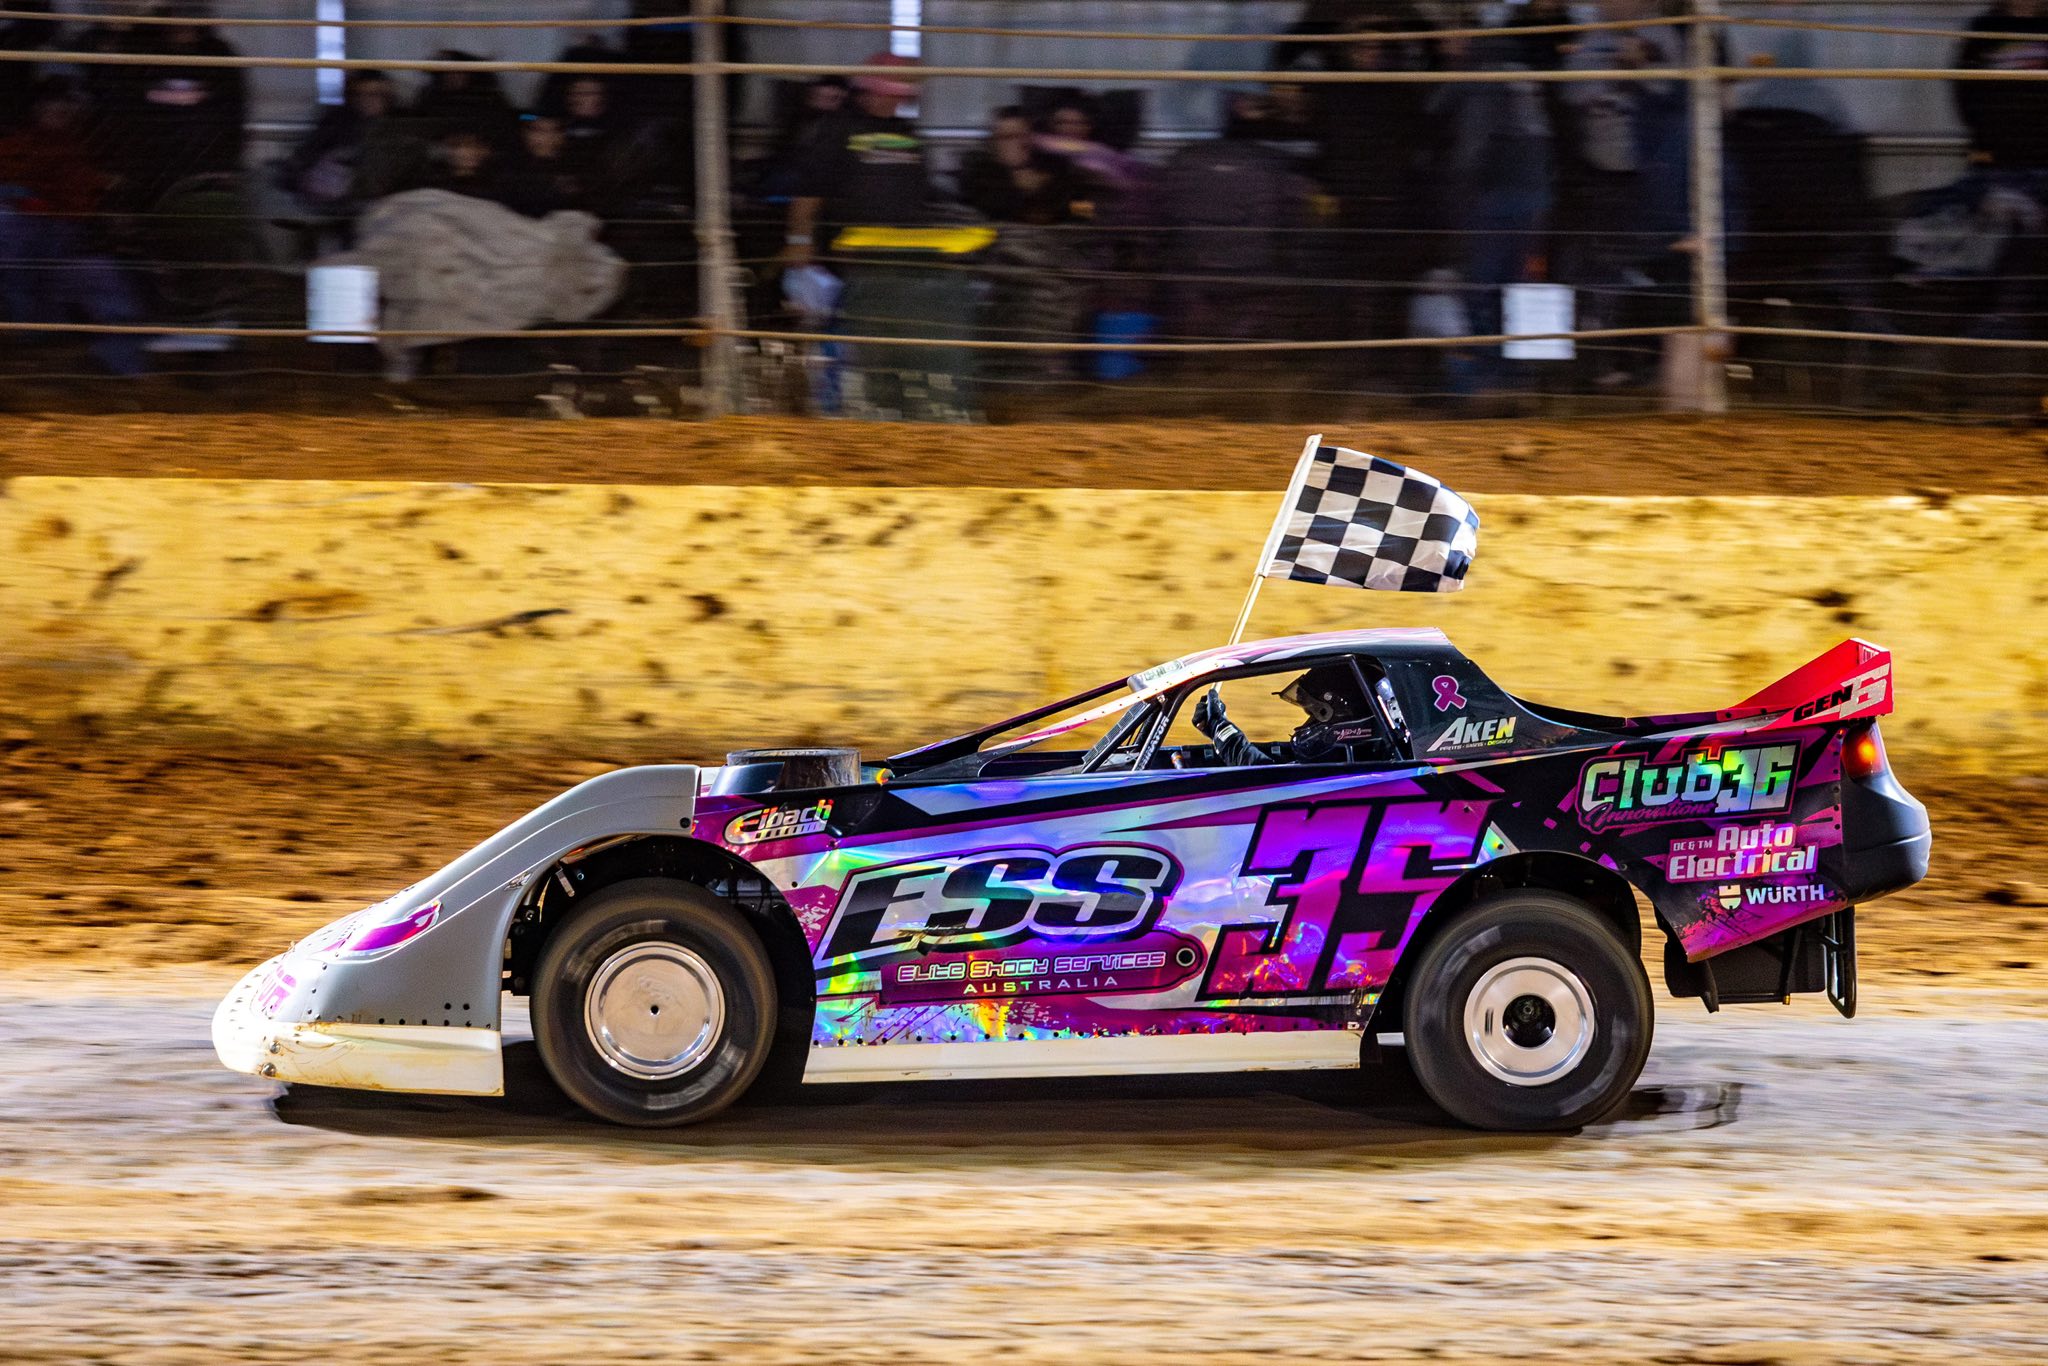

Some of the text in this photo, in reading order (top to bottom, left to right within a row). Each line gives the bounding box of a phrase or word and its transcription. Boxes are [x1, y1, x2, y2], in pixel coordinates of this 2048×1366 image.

[1426, 716, 1517, 752] AKEN
[1581, 745, 1797, 813] Club36
[724, 799, 834, 844] Eibach
[1697, 839, 1713, 849] TM
[1718, 824, 1794, 851] Auto
[1669, 845, 1816, 880] Electrical
[818, 847, 1173, 961] ESS
[1746, 884, 1824, 905] WÜRTH
[963, 976, 1118, 995] AUSTRALIA
[969, 958, 1049, 979] Shock
